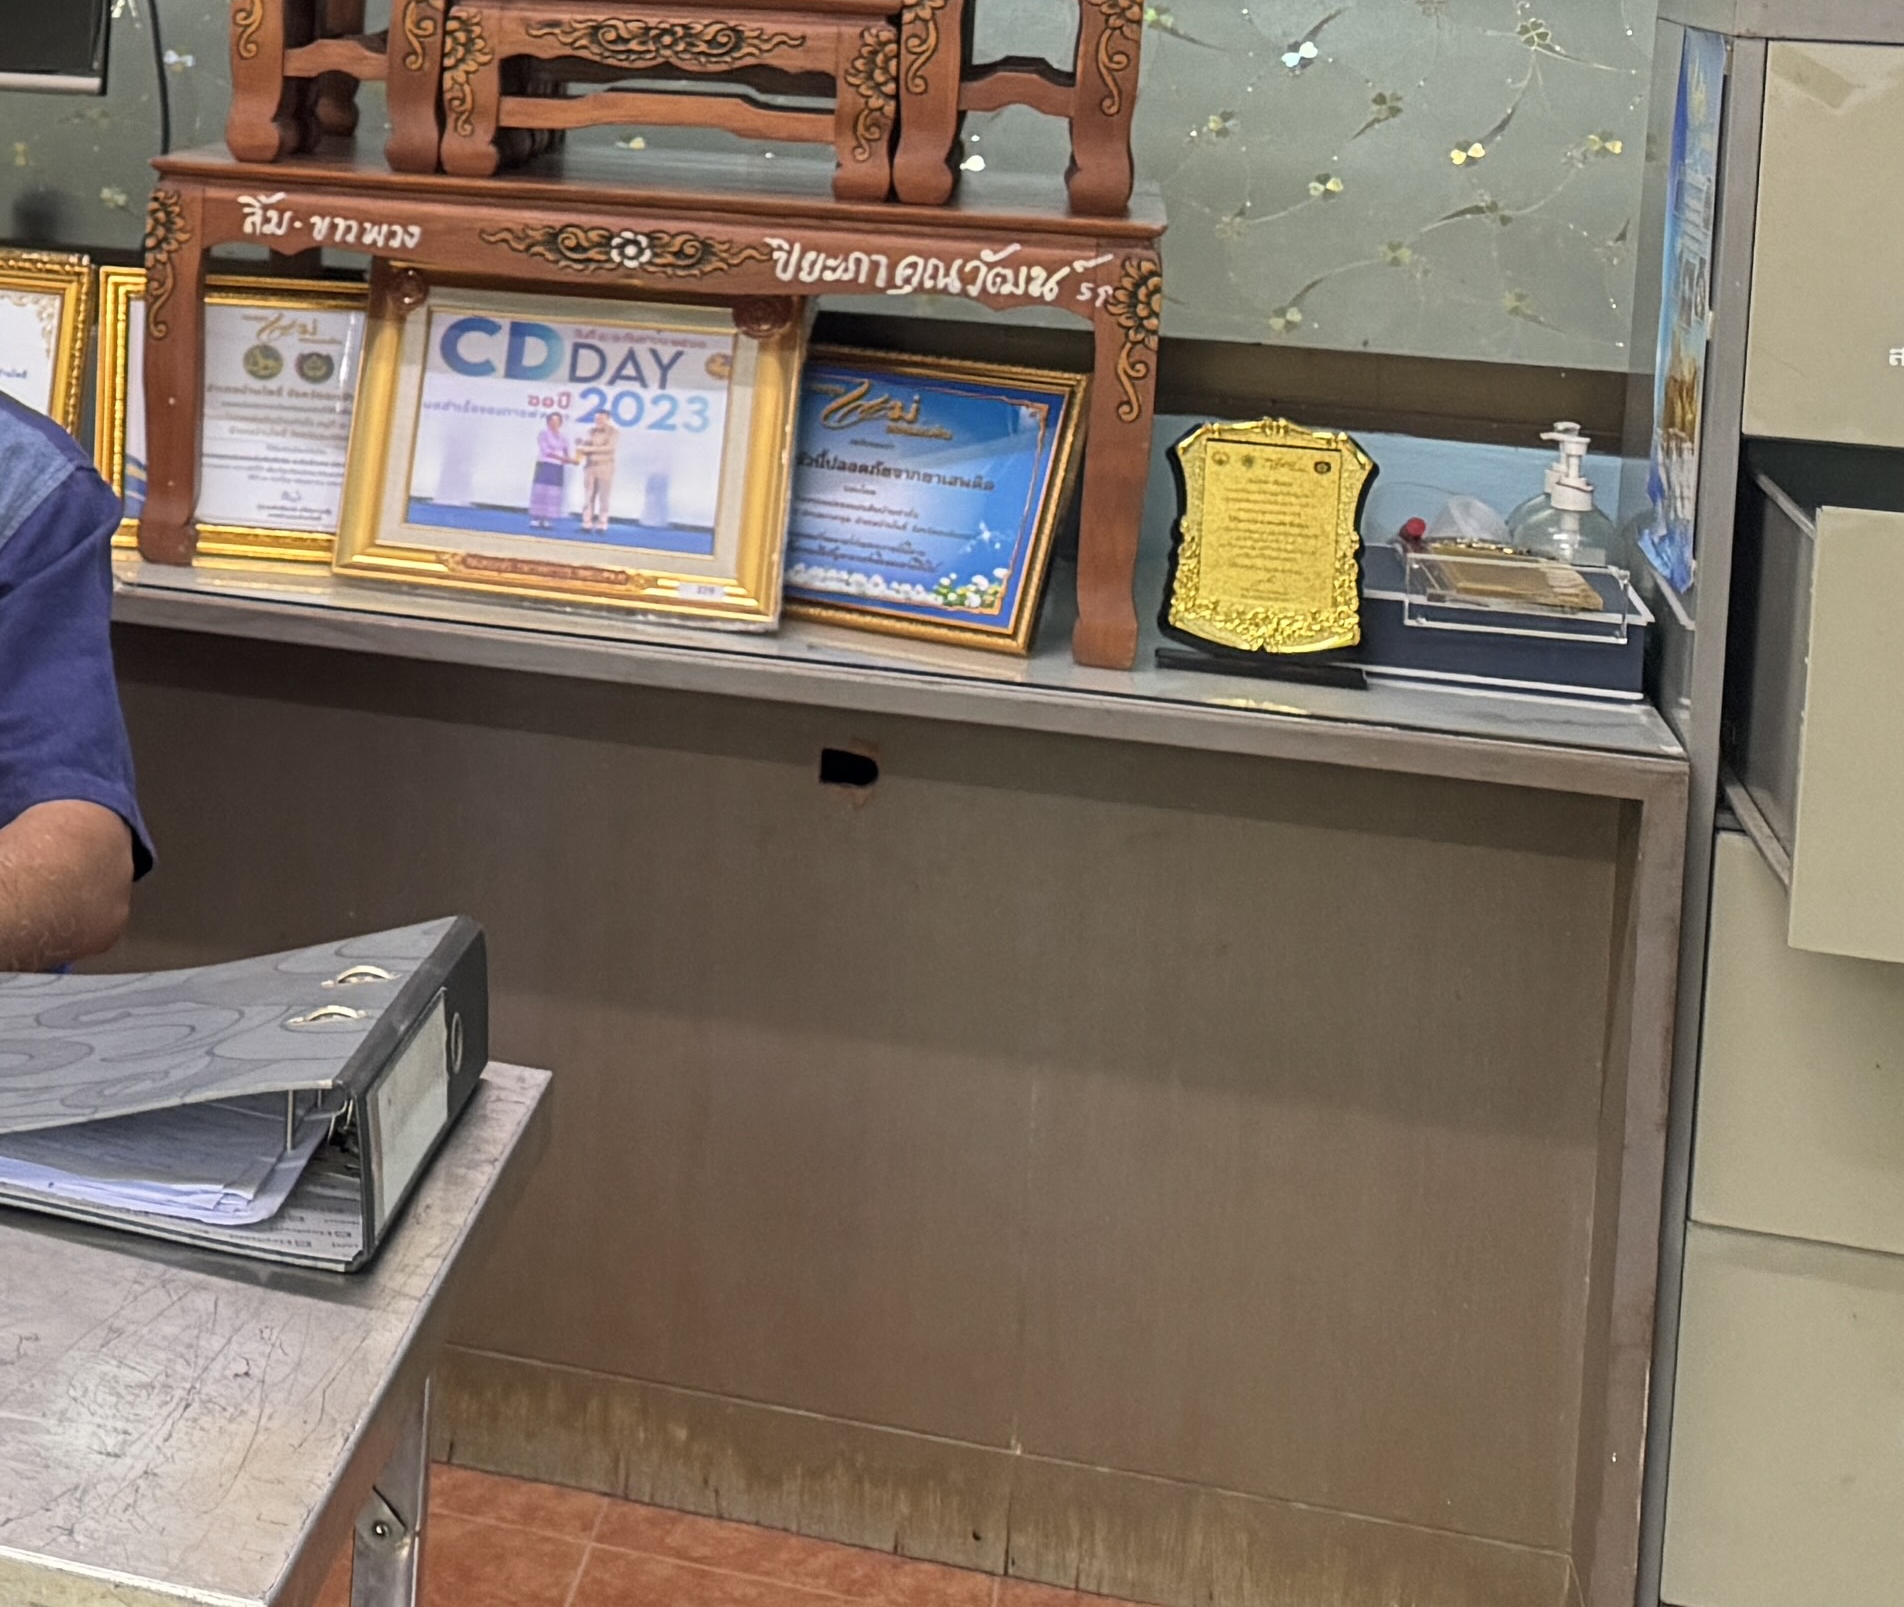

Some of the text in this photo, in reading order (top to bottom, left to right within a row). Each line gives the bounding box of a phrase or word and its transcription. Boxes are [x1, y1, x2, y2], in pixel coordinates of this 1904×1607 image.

[439, 316, 566, 381] CD
[569, 342, 685, 390] DAY
[574, 387, 710, 433] 2023
